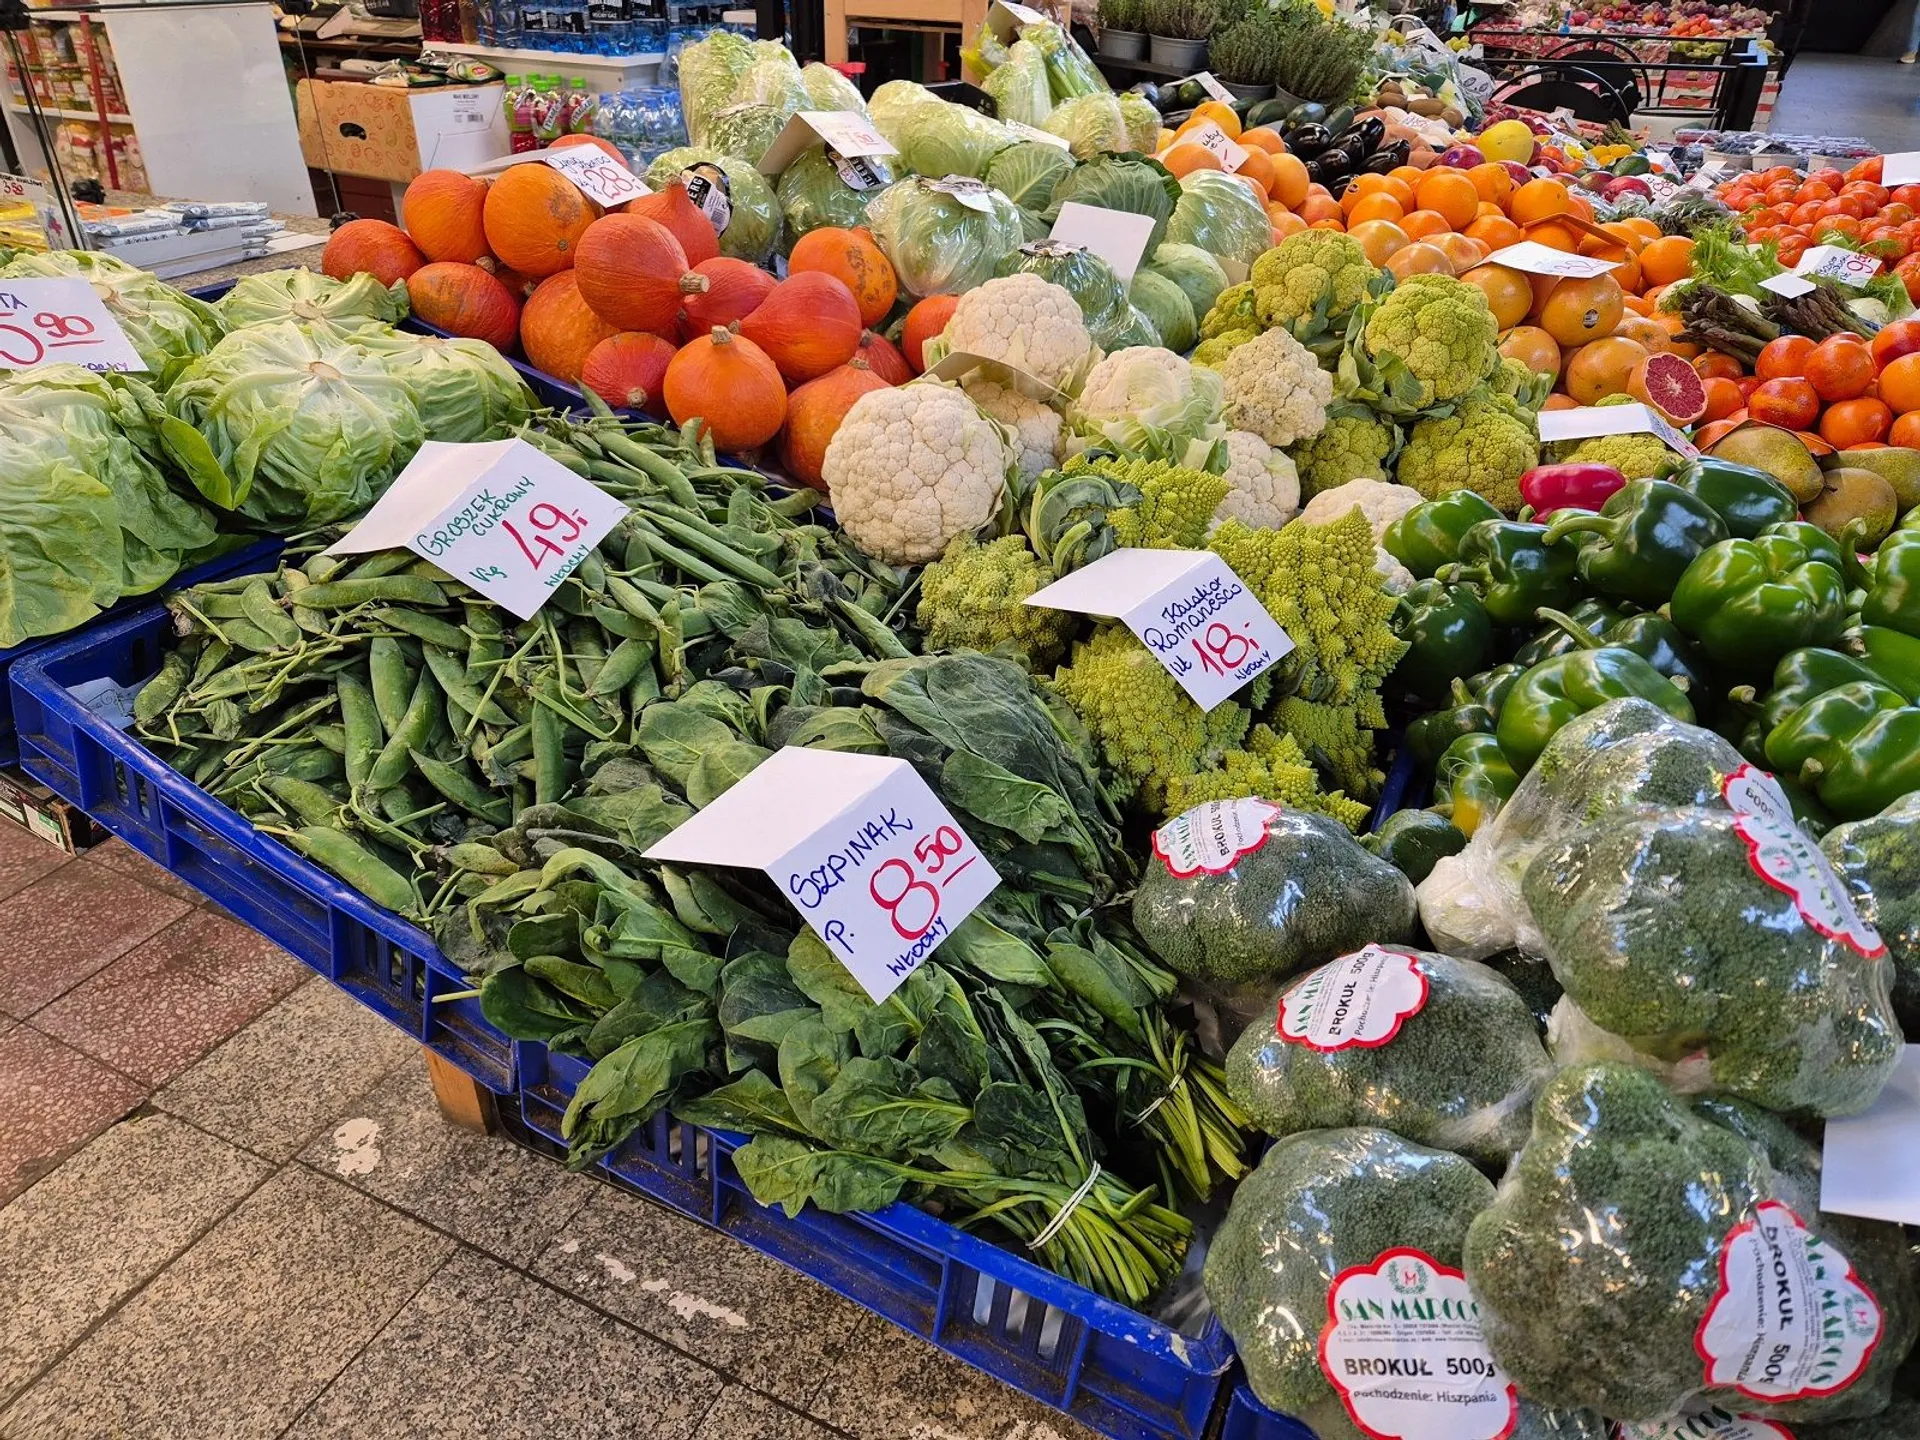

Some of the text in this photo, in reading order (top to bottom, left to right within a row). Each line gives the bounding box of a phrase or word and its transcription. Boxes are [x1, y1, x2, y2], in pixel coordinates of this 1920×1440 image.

[416, 488, 496, 556] GROSZEK
[472, 476, 535, 536] CUKROWY
[1144, 584, 1243, 652] Romanesco
[790, 808, 913, 908] SZPINAK
[886, 916, 949, 977] WŁOCHY
[1329, 952, 1375, 1036] BROKUŁ 500g
[1340, 1298, 1481, 1323] SAN MARCOS
[1765, 1226, 1794, 1331] BROKUŁ
[1344, 1358, 1433, 1376] BROKUŁ
[1436, 1390, 1497, 1406] Hiszpania
